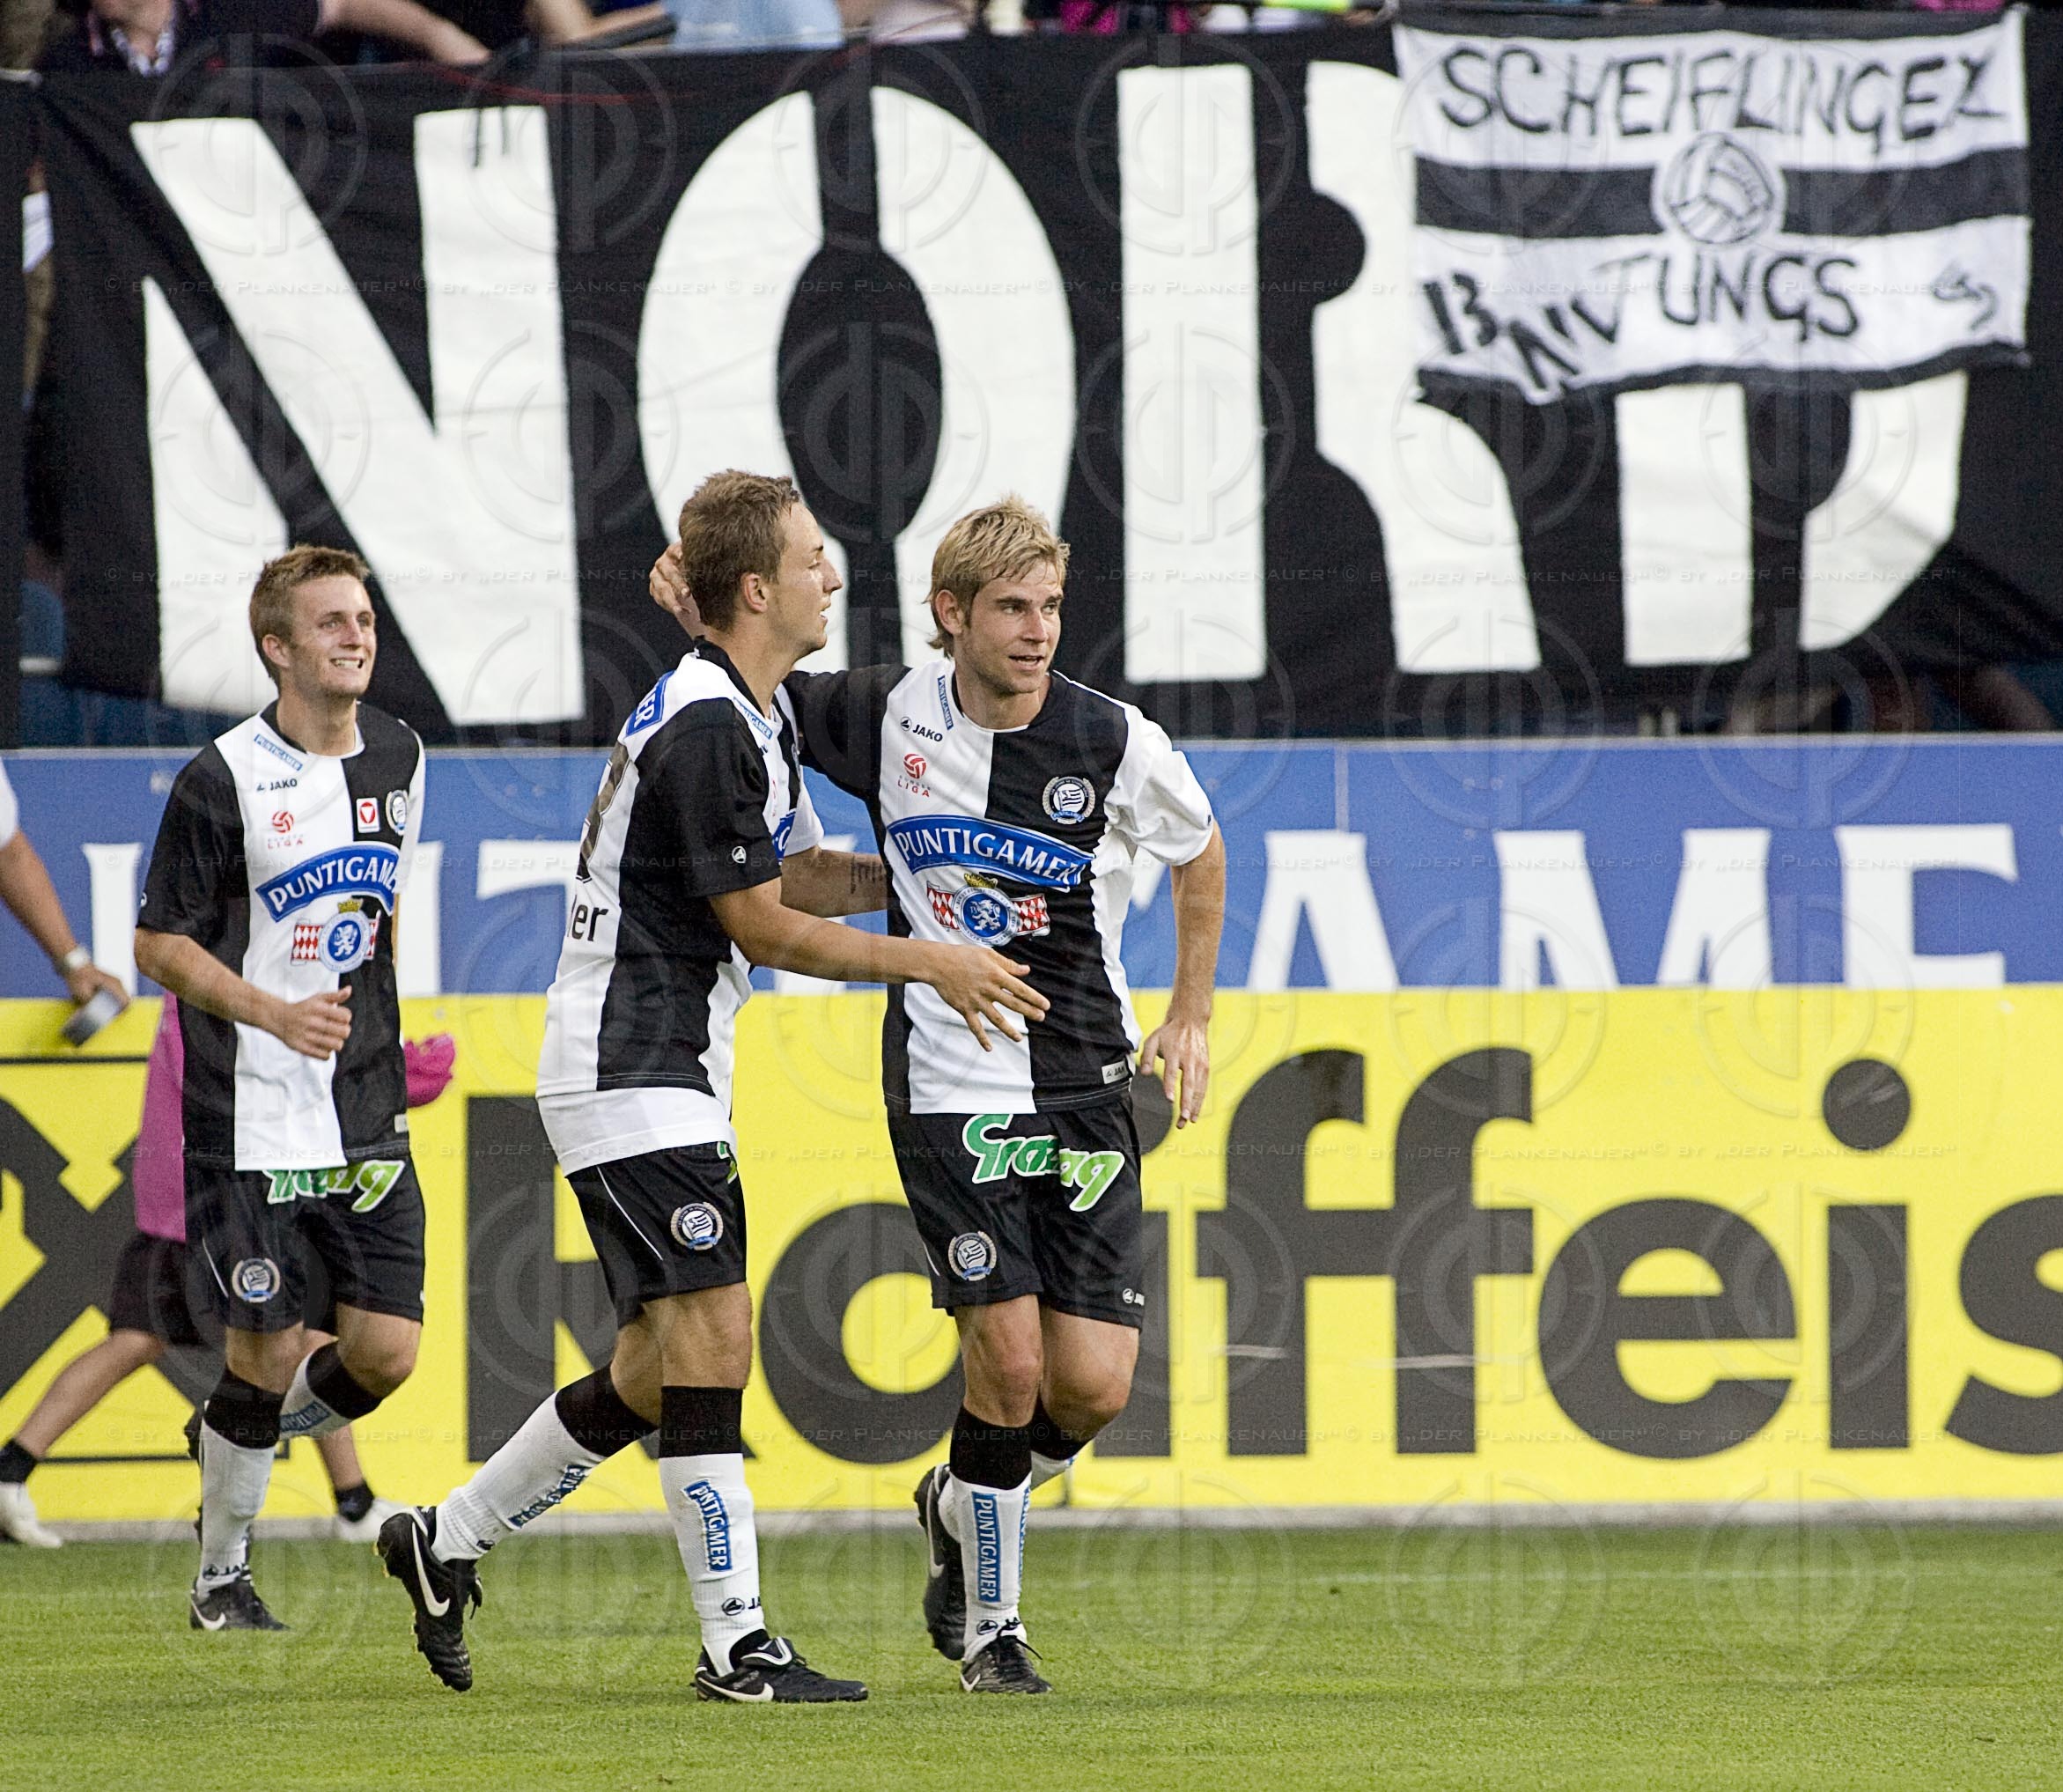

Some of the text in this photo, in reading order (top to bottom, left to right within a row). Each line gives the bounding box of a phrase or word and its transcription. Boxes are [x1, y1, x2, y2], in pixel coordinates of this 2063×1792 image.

[912, 724, 944, 742] JAKO
[270, 778, 298, 791] JAKO
[897, 779, 930, 798] LIGA
[975, 1497, 998, 1599] PUNTIGAMER
